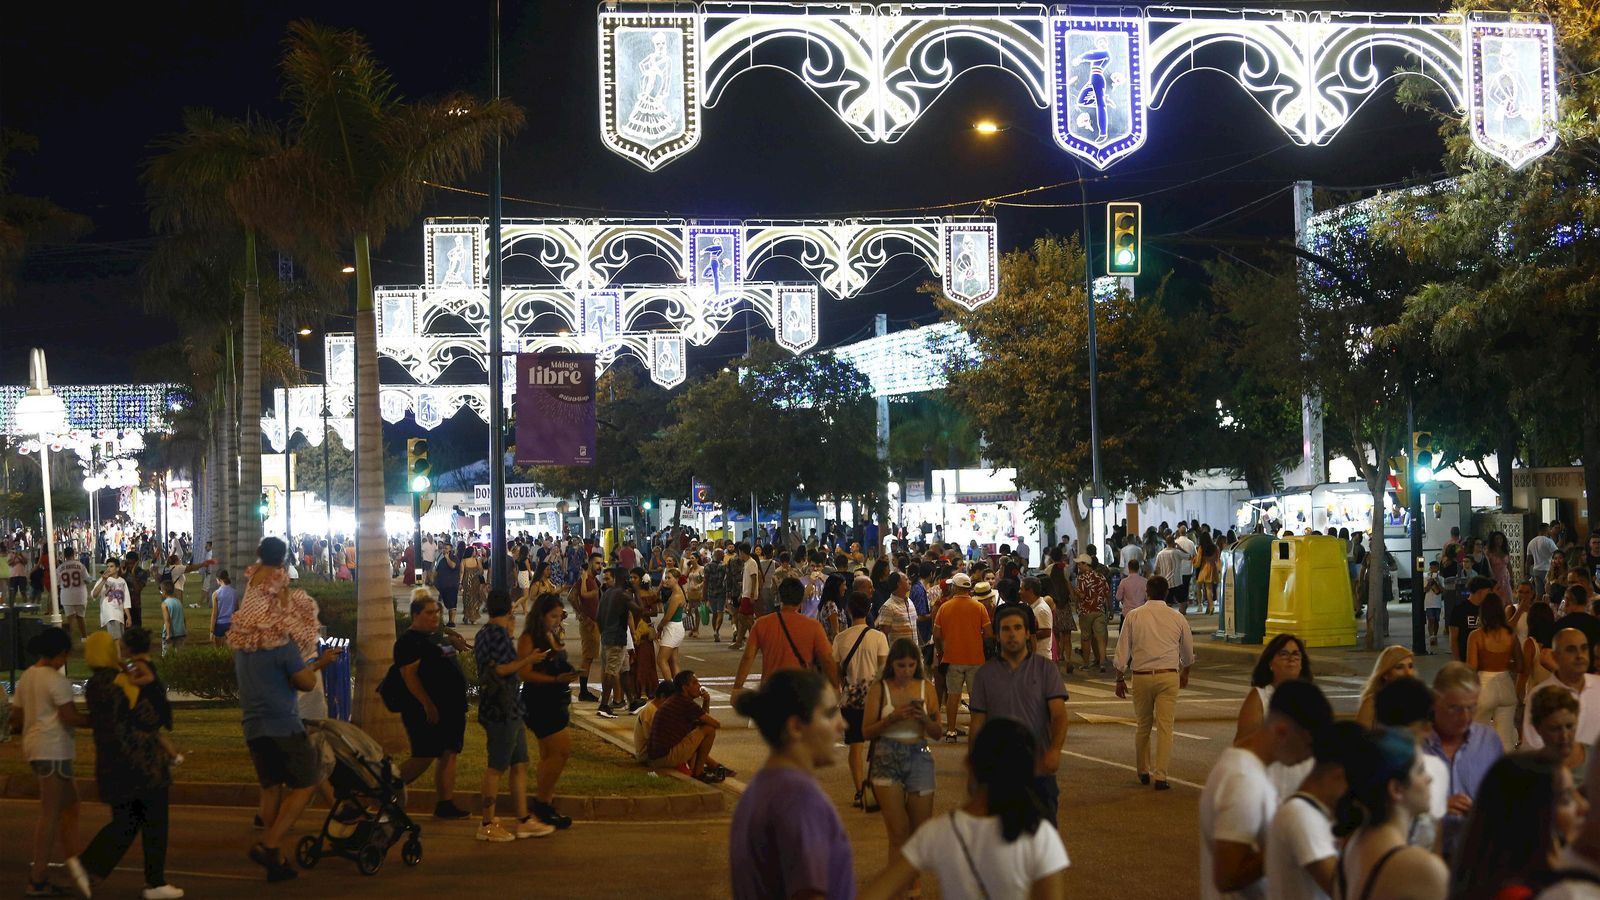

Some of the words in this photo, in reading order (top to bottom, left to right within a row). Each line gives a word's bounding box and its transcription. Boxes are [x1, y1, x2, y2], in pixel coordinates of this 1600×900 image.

[551, 361, 579, 370] Málaga
[528, 365, 582, 384] libre
[61, 571, 81, 588] 99
